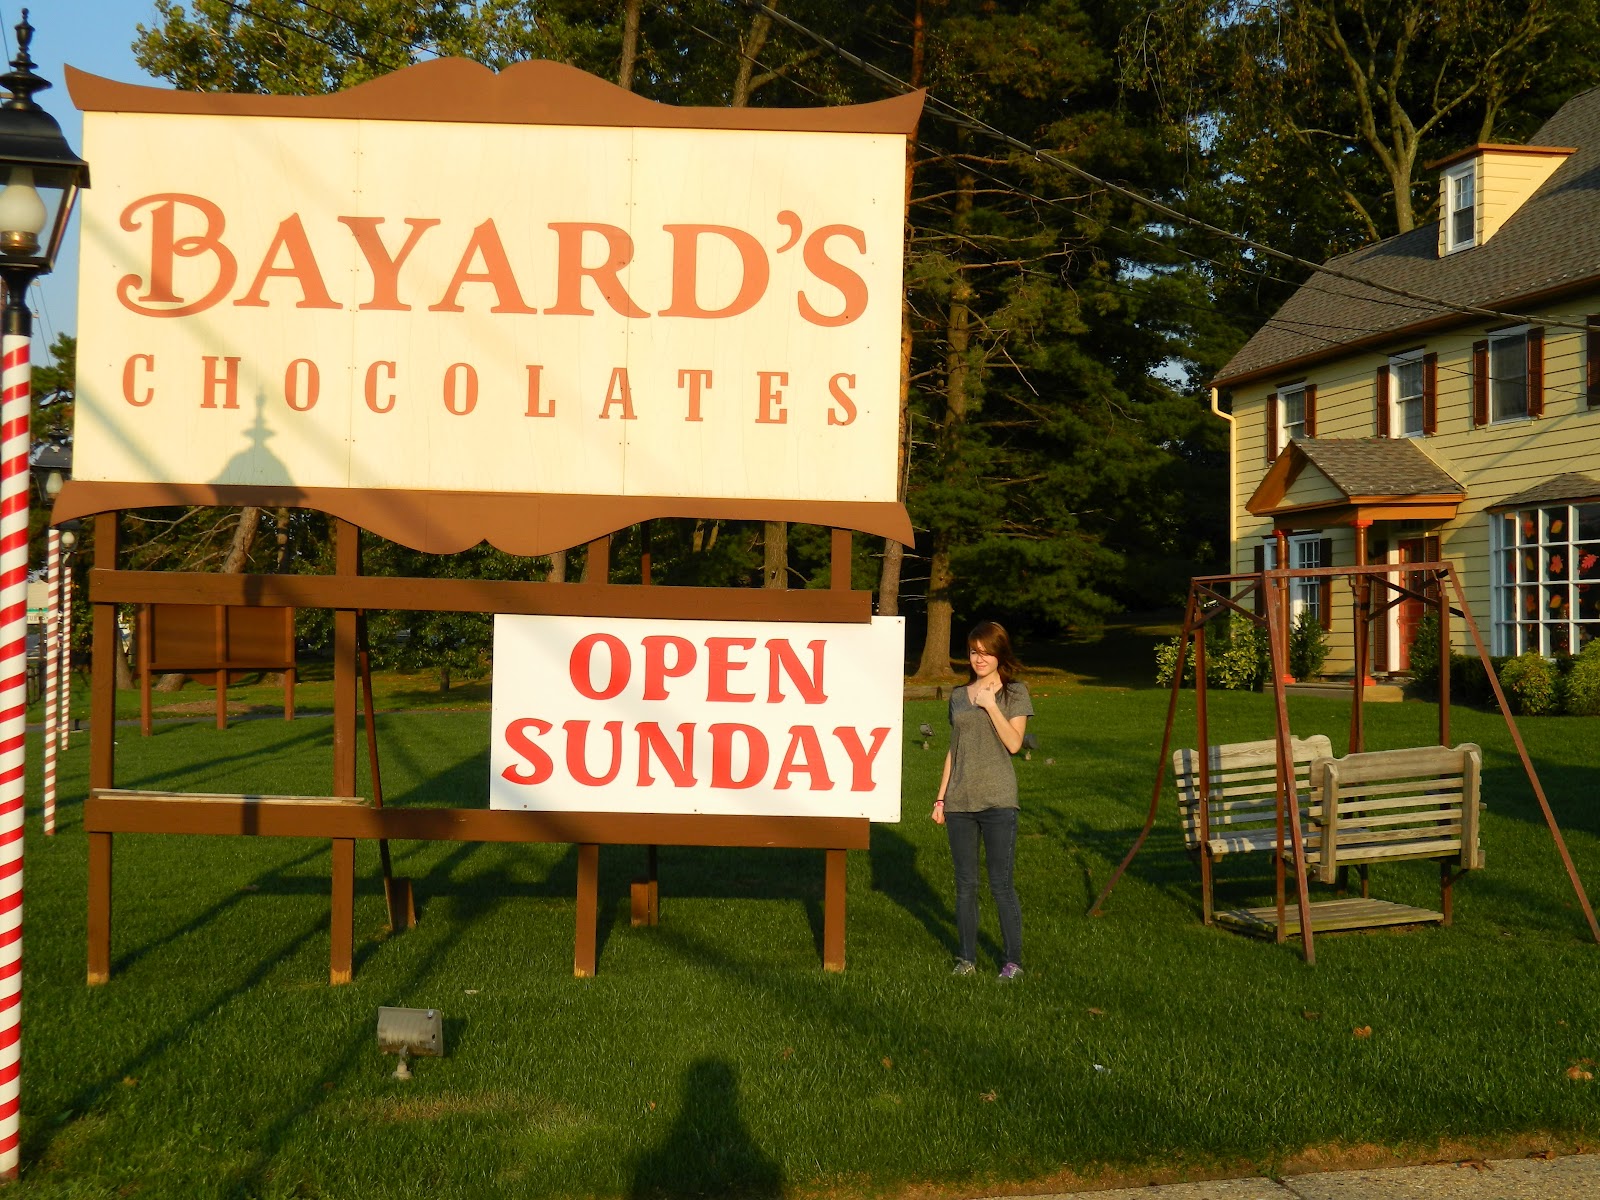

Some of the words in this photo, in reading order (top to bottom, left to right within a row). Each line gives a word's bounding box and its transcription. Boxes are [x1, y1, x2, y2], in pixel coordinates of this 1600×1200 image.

[118, 193, 868, 327] BAYARD'S
[122, 353, 857, 426] CHOCOLATES
[569, 633, 828, 704] OPEN
[501, 718, 891, 792] SUNDAY
